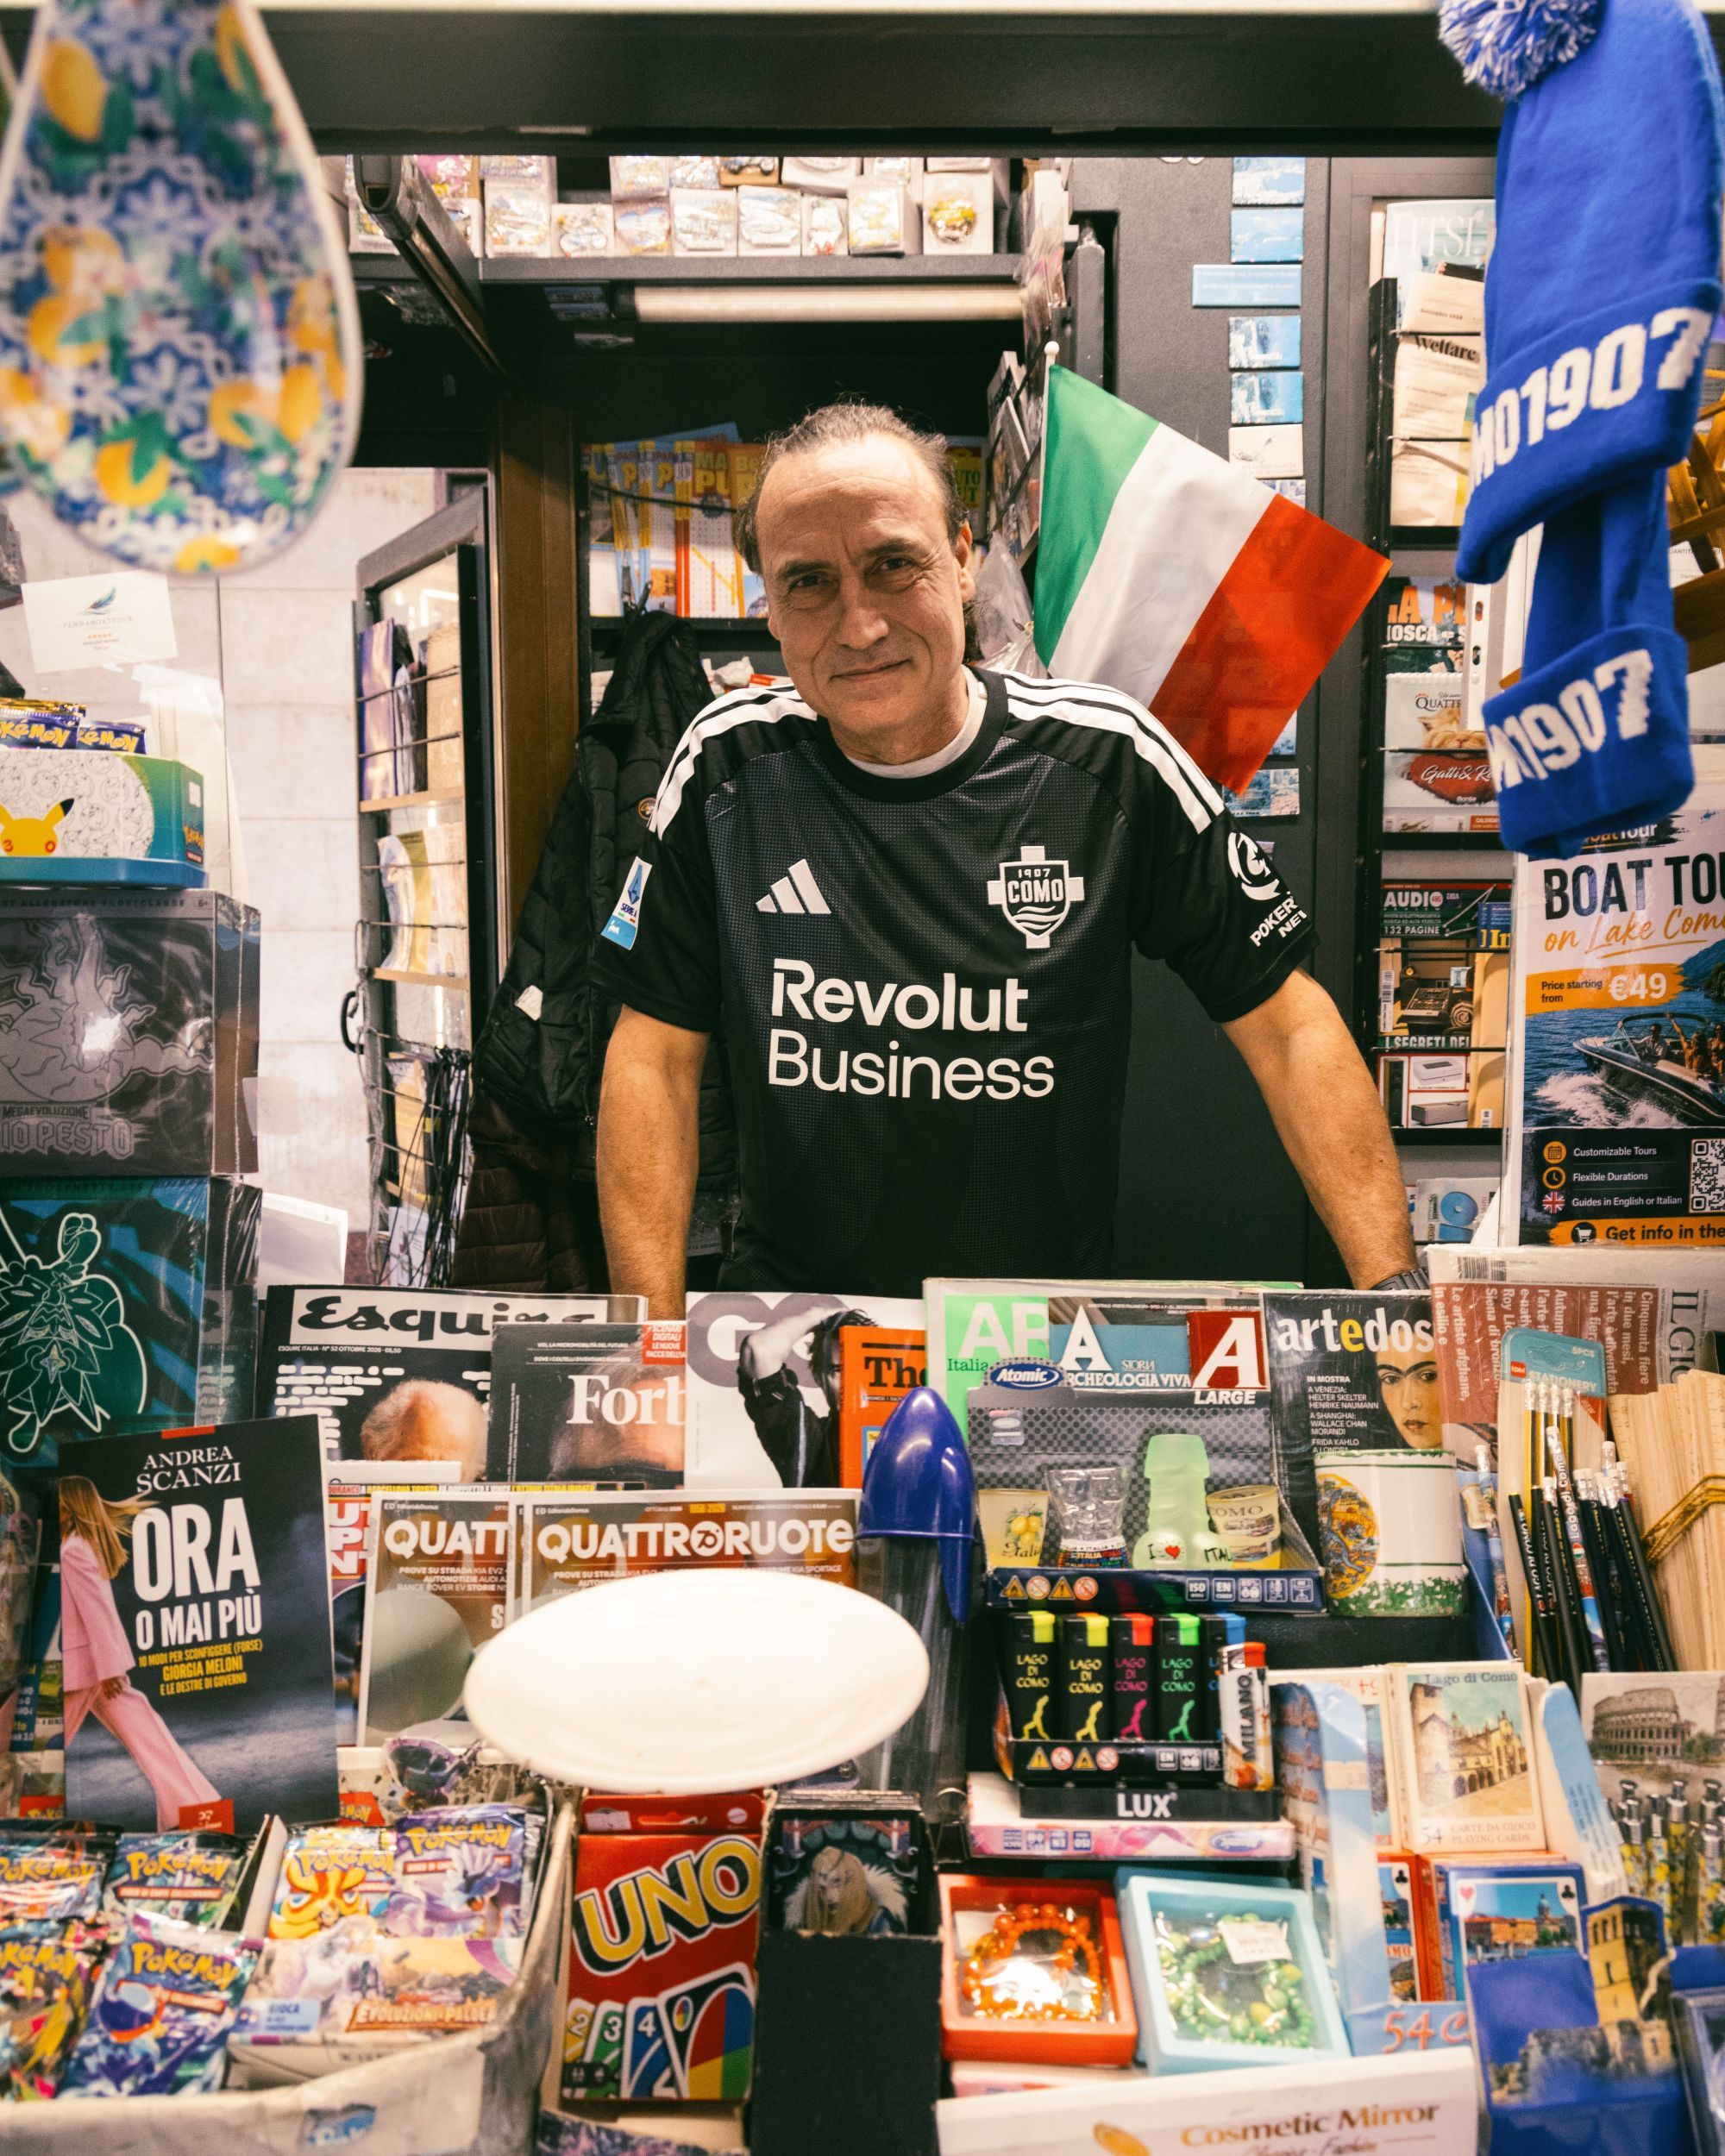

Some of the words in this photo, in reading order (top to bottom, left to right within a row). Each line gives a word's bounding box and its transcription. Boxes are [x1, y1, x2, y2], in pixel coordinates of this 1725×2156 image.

[1414, 334, 1477, 361] Welfare
[1469, 306, 1713, 489] MO1907
[1486, 649, 1654, 793] M1907
[1018, 868, 1051, 879] 1907
[1007, 879, 1064, 904] COMO
[1544, 859, 1653, 920] BOAT
[1665, 852, 1725, 906] TO
[1383, 892, 1443, 907] AUDIO
[1384, 925, 1402, 934] 132
[1404, 925, 1440, 934] PAGINE
[1544, 929, 1579, 952] on
[1584, 912, 1655, 955] Lake
[1541, 981, 1565, 991] Price
[1566, 979, 1603, 991] starting
[1609, 972, 1667, 1001] €49
[772, 958, 1028, 1031] Revolut
[1541, 994, 1564, 1003] from
[1394, 1037, 1446, 1048] SEGRETI
[768, 1029, 1055, 1100] Business
[3, 1106, 89, 1119] MEGAEVOLUZIONE
[36, 1119, 133, 1159] PESTO
[1573, 1148, 1632, 1157] Customizable
[1634, 1146, 1657, 1156] Tours
[1573, 1173, 1605, 1182] Flexible
[1607, 1172, 1648, 1181] Durations
[1571, 1198, 1602, 1207] Guides
[1613, 1197, 1644, 1207] English
[1656, 1196, 1683, 1205] Italian
[1606, 1225, 1635, 1240] Get
[1641, 1224, 1673, 1239] info
[1678, 1224, 1694, 1239] in
[1699, 1223, 1725, 1239] the
[1433, 1286, 1447, 1299] in
[1452, 1286, 1465, 1302] Le
[1502, 1288, 1515, 1311] Roy
[1624, 1290, 1636, 1303] in
[1486, 1287, 1498, 1321] Siena
[1589, 1290, 1599, 1313] una
[1670, 1288, 1699, 1325] IL
[1435, 1301, 1450, 1334] esilio
[1452, 1305, 1467, 1345] artiste
[1622, 1306, 1635, 1329] due
[1638, 1291, 1653, 1353] Cinquanta
[652, 1332, 682, 1341] DIGITALI
[1277, 1307, 1435, 1353] artedos
[1489, 1324, 1501, 1336] di
[687, 1292, 862, 1388] GQ
[1438, 1337, 1448, 1345] e
[1620, 1332, 1634, 1364] mesi,
[1192, 1317, 1267, 1388] A
[947, 1358, 989, 1372] Italia
[1606, 1337, 1619, 1394] diventata
[1639, 1356, 1652, 1385] fiere
[996, 1367, 1049, 1382] Atomic
[1160, 1372, 1191, 1388] VIVA
[1456, 1348, 1471, 1401] afghane,
[1528, 1369, 1596, 1393] STATIONERY
[1194, 1390, 1257, 1405] LARGE
[143, 1445, 234, 1470] ANDREA
[136, 1462, 242, 1493] SCANZI
[385, 1519, 509, 1560] QUATT
[132, 1497, 261, 1602] ORA
[399, 1566, 427, 1575] PROVE
[428, 1566, 440, 1575] SU
[441, 1566, 473, 1575] STRADA
[553, 1570, 581, 1579] PROVE
[806, 1564, 843, 1573] SPORTAGE
[423, 1575, 478, 1583] AUTONOTIZIE
[397, 1583, 425, 1592] RANGE
[426, 1583, 455, 1592] ROVER
[467, 1583, 496, 1592] STORIE
[1189, 1582, 1207, 1593] ISO
[1215, 1582, 1232, 1593] EN
[135, 1609, 154, 1651] O
[160, 1601, 212, 1648] MAI
[218, 1588, 262, 1639] PIÙ
[139, 1655, 147, 1668] 10
[148, 1652, 168, 1666] MODI
[169, 1650, 184, 1664] PER
[185, 1642, 233, 1661] SCONFIGGERE
[234, 1638, 264, 1655] (FORSE)
[1016, 1653, 1049, 1667] LAGO
[162, 1661, 204, 1682] GIORGIA
[205, 1655, 244, 1676] MELONI
[1027, 1666, 1039, 1677] DI
[1070, 1658, 1102, 1671] LAGO
[1114, 1657, 1146, 1670] LAGO
[1162, 1657, 1194, 1670] LAGO
[1016, 1676, 1050, 1689] COMO
[1080, 1671, 1093, 1682] DI
[1125, 1670, 1138, 1680] DI
[1172, 1670, 1184, 1681] DI
[1425, 1673, 1460, 1687] Lago
[1464, 1672, 1477, 1683] di
[1480, 1671, 1518, 1683] Como
[160, 1684, 166, 1696] E
[166, 1683, 175, 1695] LE
[176, 1678, 204, 1694] DESTRE
[204, 1677, 213, 1689] DI
[214, 1672, 248, 1689] GOVERNO
[1069, 1681, 1104, 1695] COMO
[1114, 1680, 1148, 1693] COMO
[1161, 1681, 1195, 1693] COMO
[1239, 1672, 1254, 1761] MILANO
[1117, 1792, 1172, 1819] LUX
[1450, 1823, 1482, 1833] CARTE
[1487, 1822, 1501, 1833] DA
[1503, 1821, 1536, 1831] GIOCO
[1421, 1827, 1443, 1845] 54
[1452, 1834, 1495, 1844] PLAYING
[1497, 1833, 1531, 1843] CARDS
[574, 1836, 761, 1973] UNO
[570, 2014, 588, 2036] 2
[604, 2016, 622, 2041] 3
[637, 2011, 657, 2037] 4
[1383, 2009, 1435, 2053] 54
[1181, 2111, 1330, 2147] Cosmetic
[1339, 2103, 1440, 2133] Mirror
